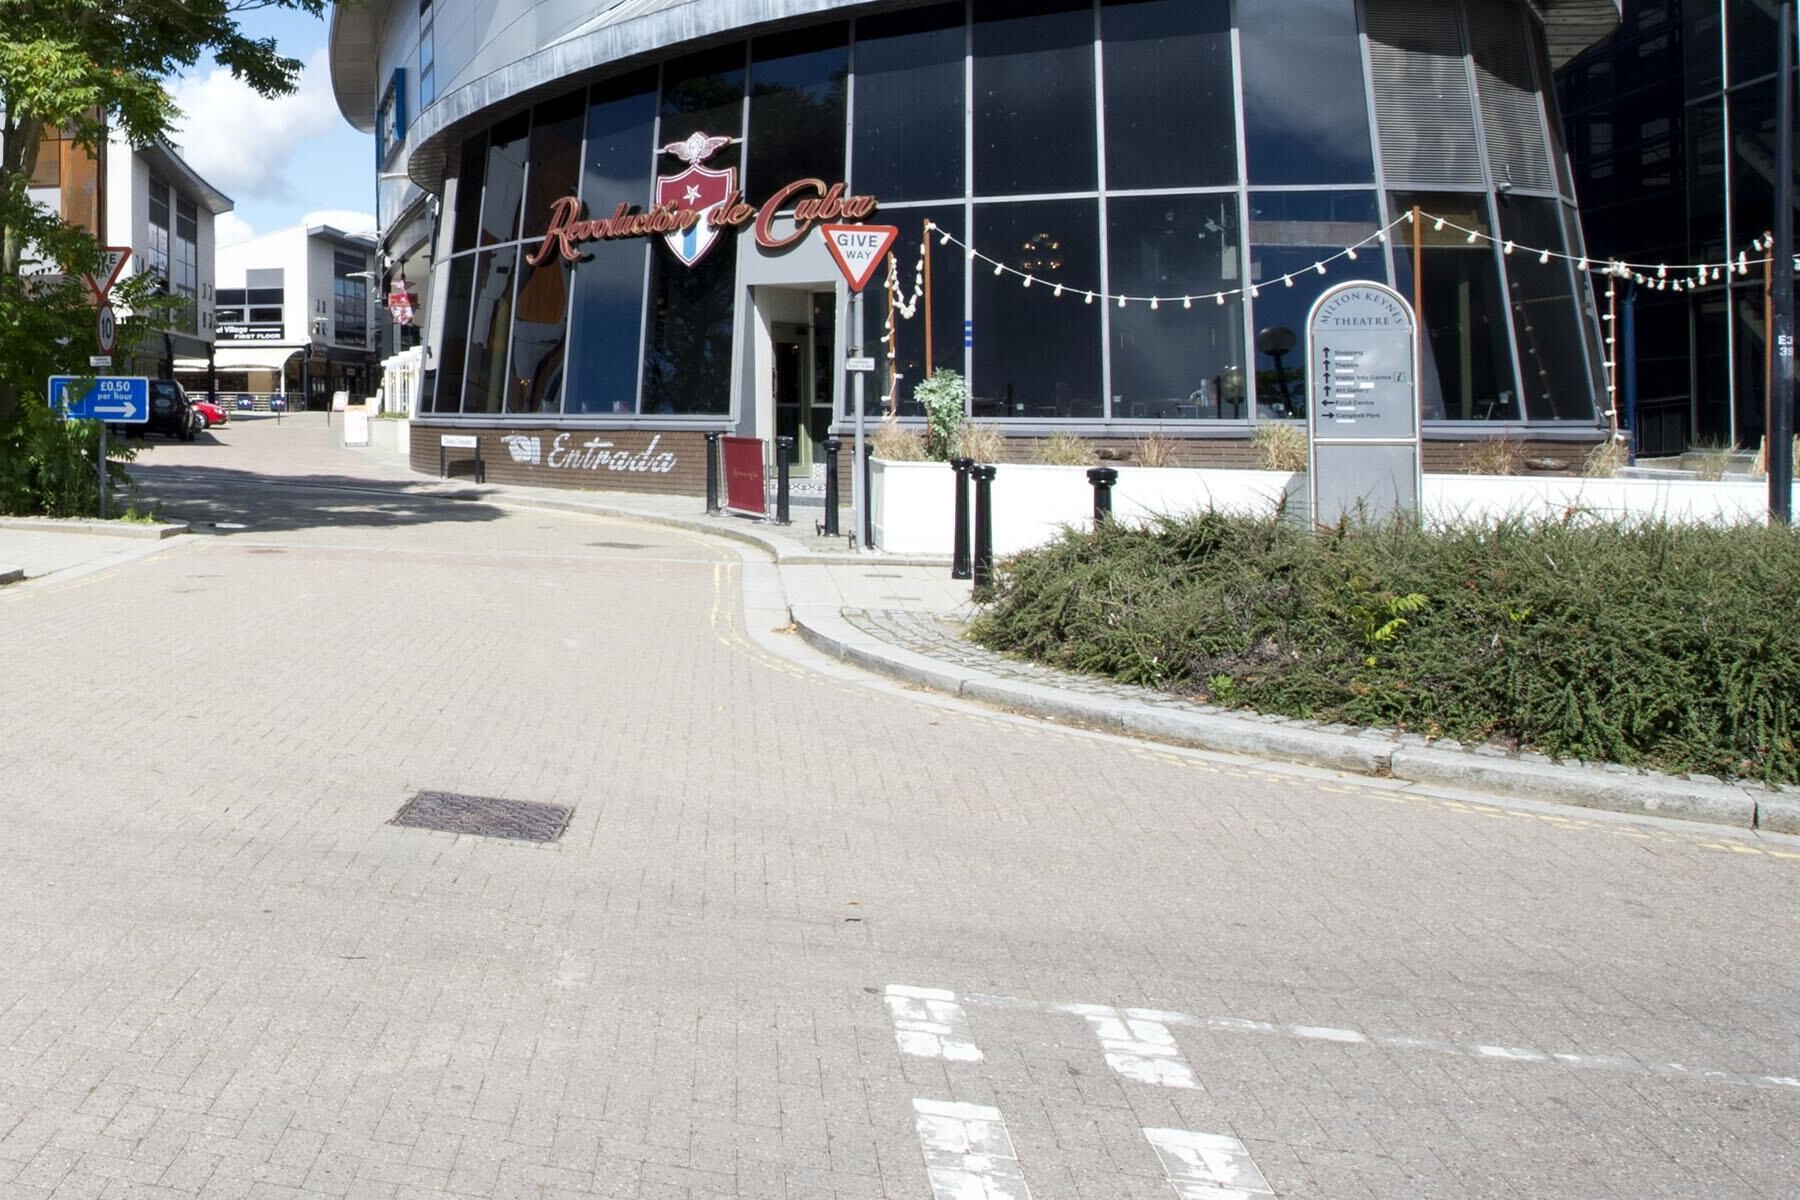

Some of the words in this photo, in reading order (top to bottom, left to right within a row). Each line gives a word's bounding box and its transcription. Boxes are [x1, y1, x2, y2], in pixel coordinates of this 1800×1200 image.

[525, 196, 704, 266] Revolución
[707, 189, 755, 226] de
[755, 177, 880, 248] Cuba
[837, 233, 878, 247] GIVE
[846, 250, 871, 259] WAY
[1320, 292, 1360, 325] MILTON
[1365, 292, 1403, 324] KEYNES
[1334, 317, 1389, 326] THEATRE
[101, 317, 112, 339] 10
[223, 326, 248, 334] Village
[1778, 335, 1793, 345] E3
[100, 380, 131, 392] £0.50
[97, 393, 111, 401] per
[113, 391, 133, 401] hour
[547, 432, 678, 473] Entrada
